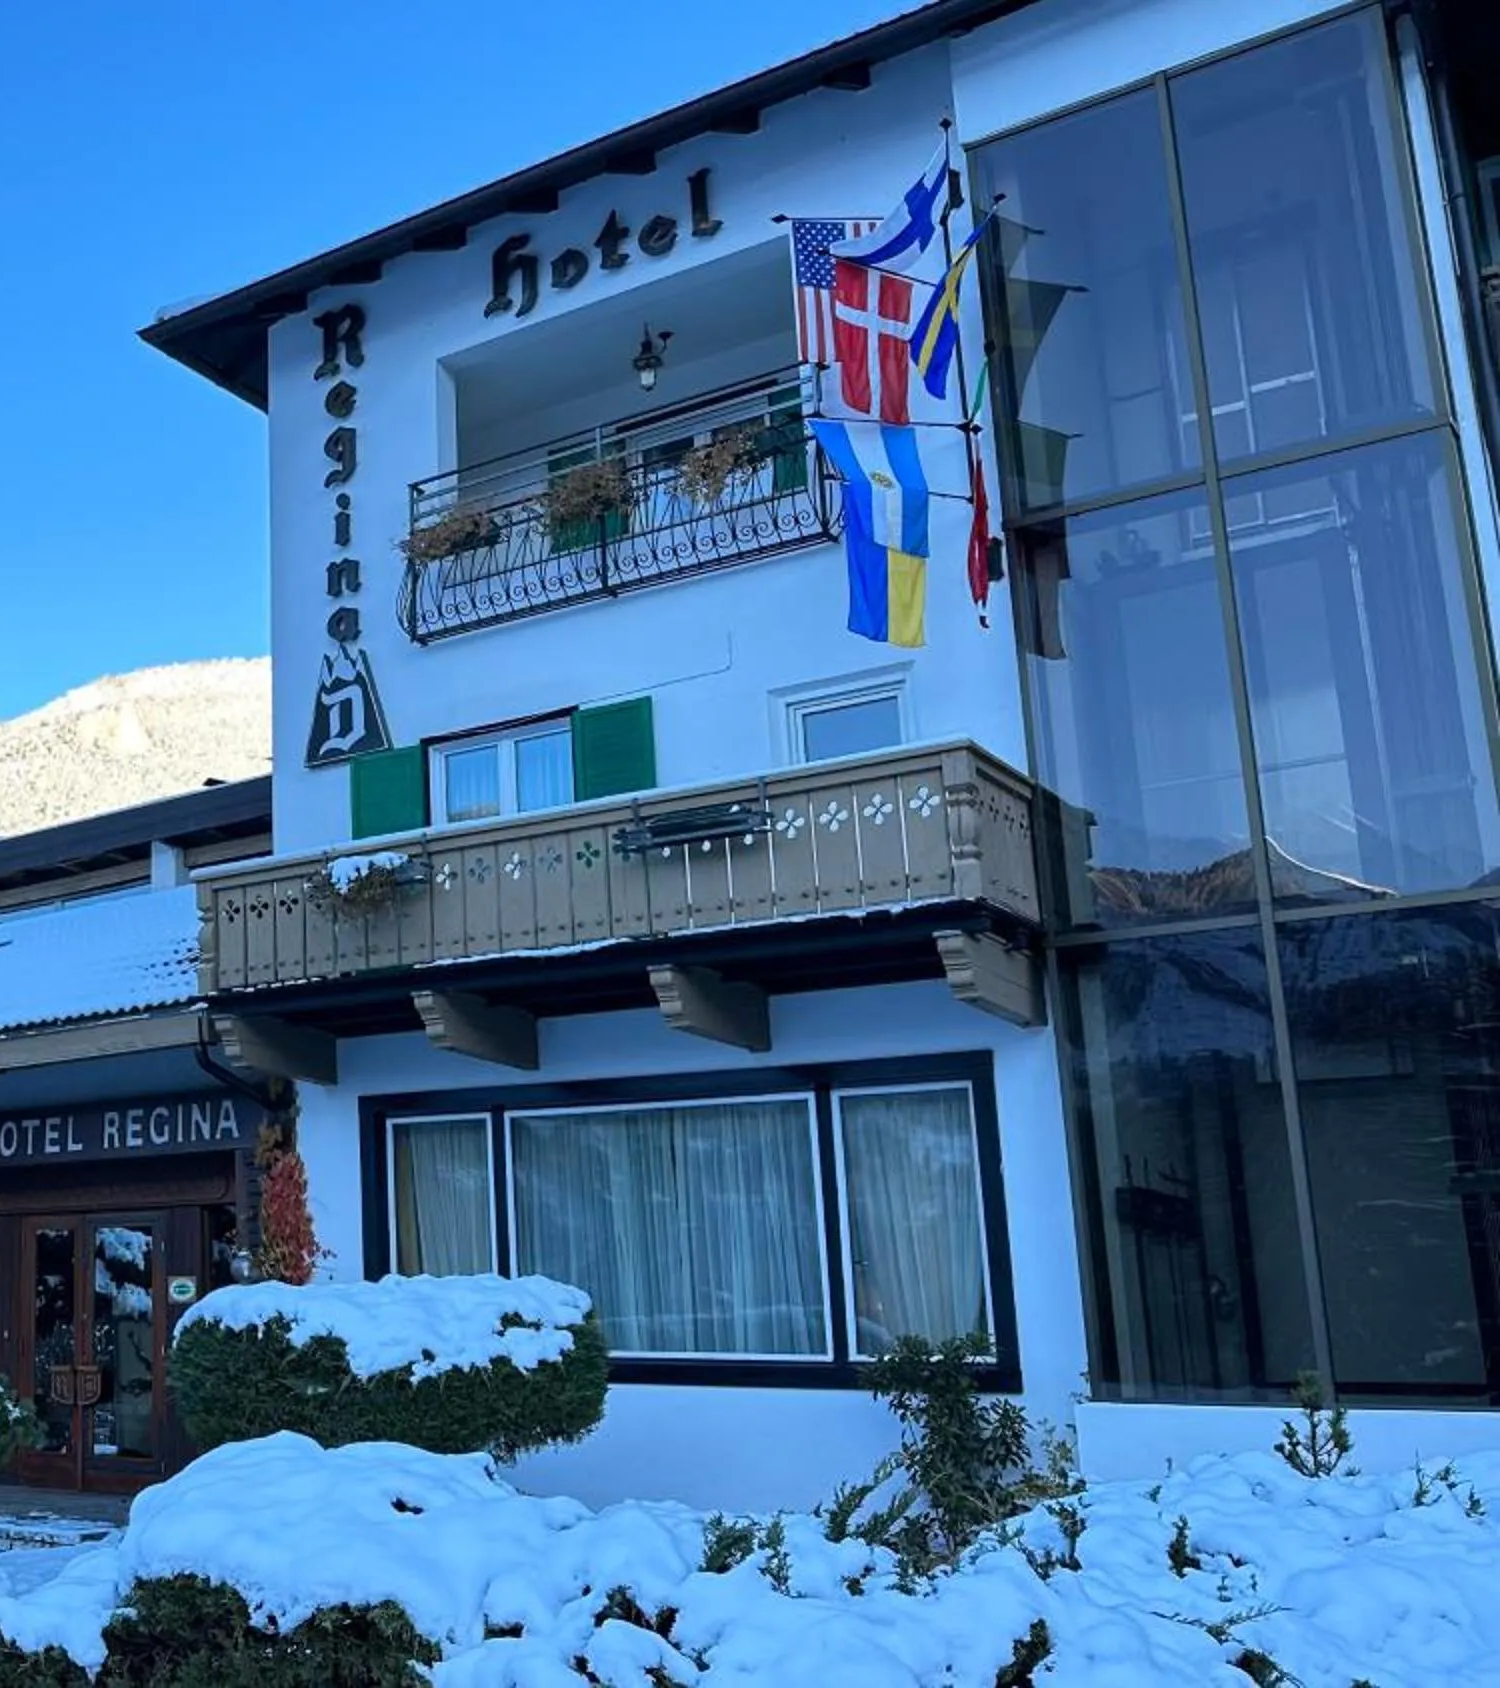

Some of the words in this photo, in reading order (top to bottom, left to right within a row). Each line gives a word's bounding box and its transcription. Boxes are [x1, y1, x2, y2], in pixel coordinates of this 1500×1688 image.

[483, 166, 723, 319] Hotel
[313, 303, 367, 643] Regina
[103, 1099, 241, 1150] REGINA
